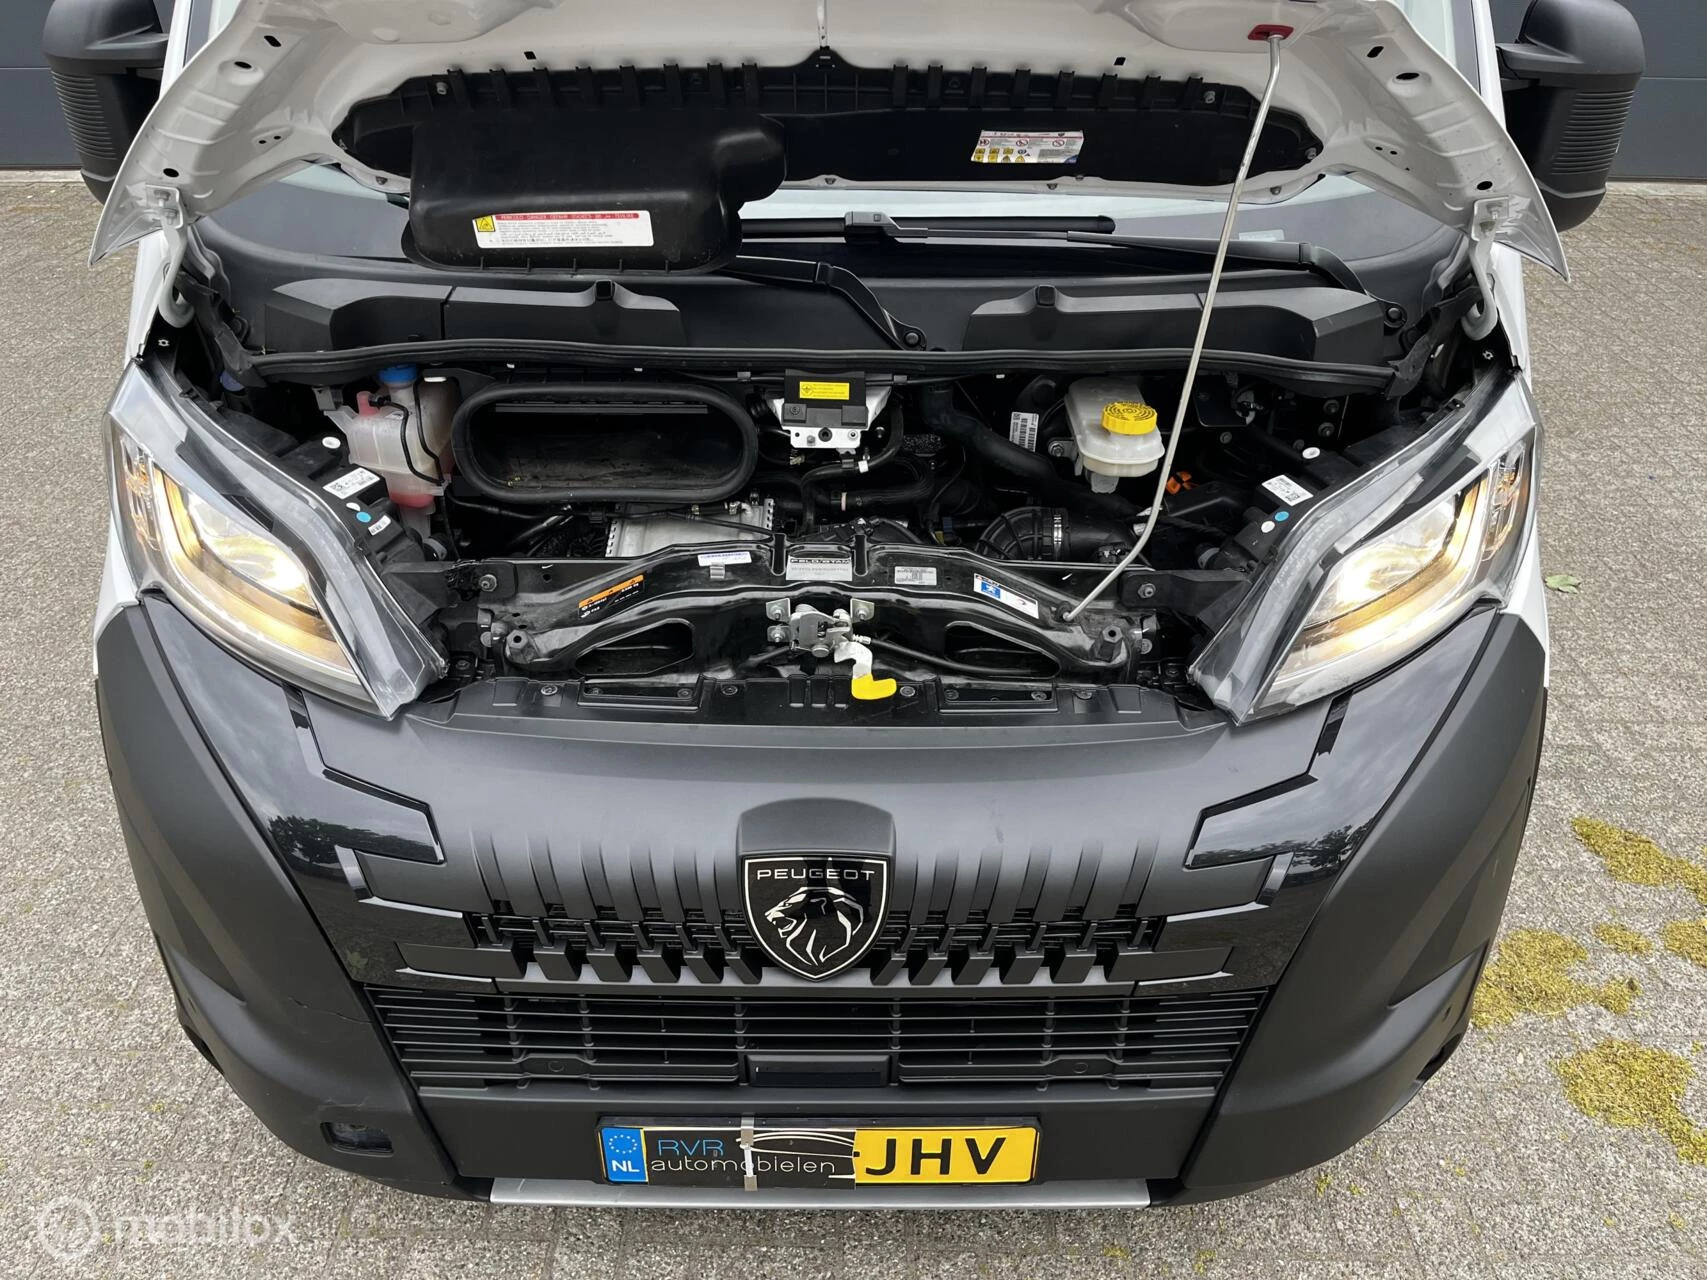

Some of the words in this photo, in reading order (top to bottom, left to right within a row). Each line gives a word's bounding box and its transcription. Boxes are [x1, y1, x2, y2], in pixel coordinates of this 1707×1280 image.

[757, 868, 875, 881] PEUGEOT
[658, 1139, 724, 1156] RVR
[612, 1160, 640, 1172] NL
